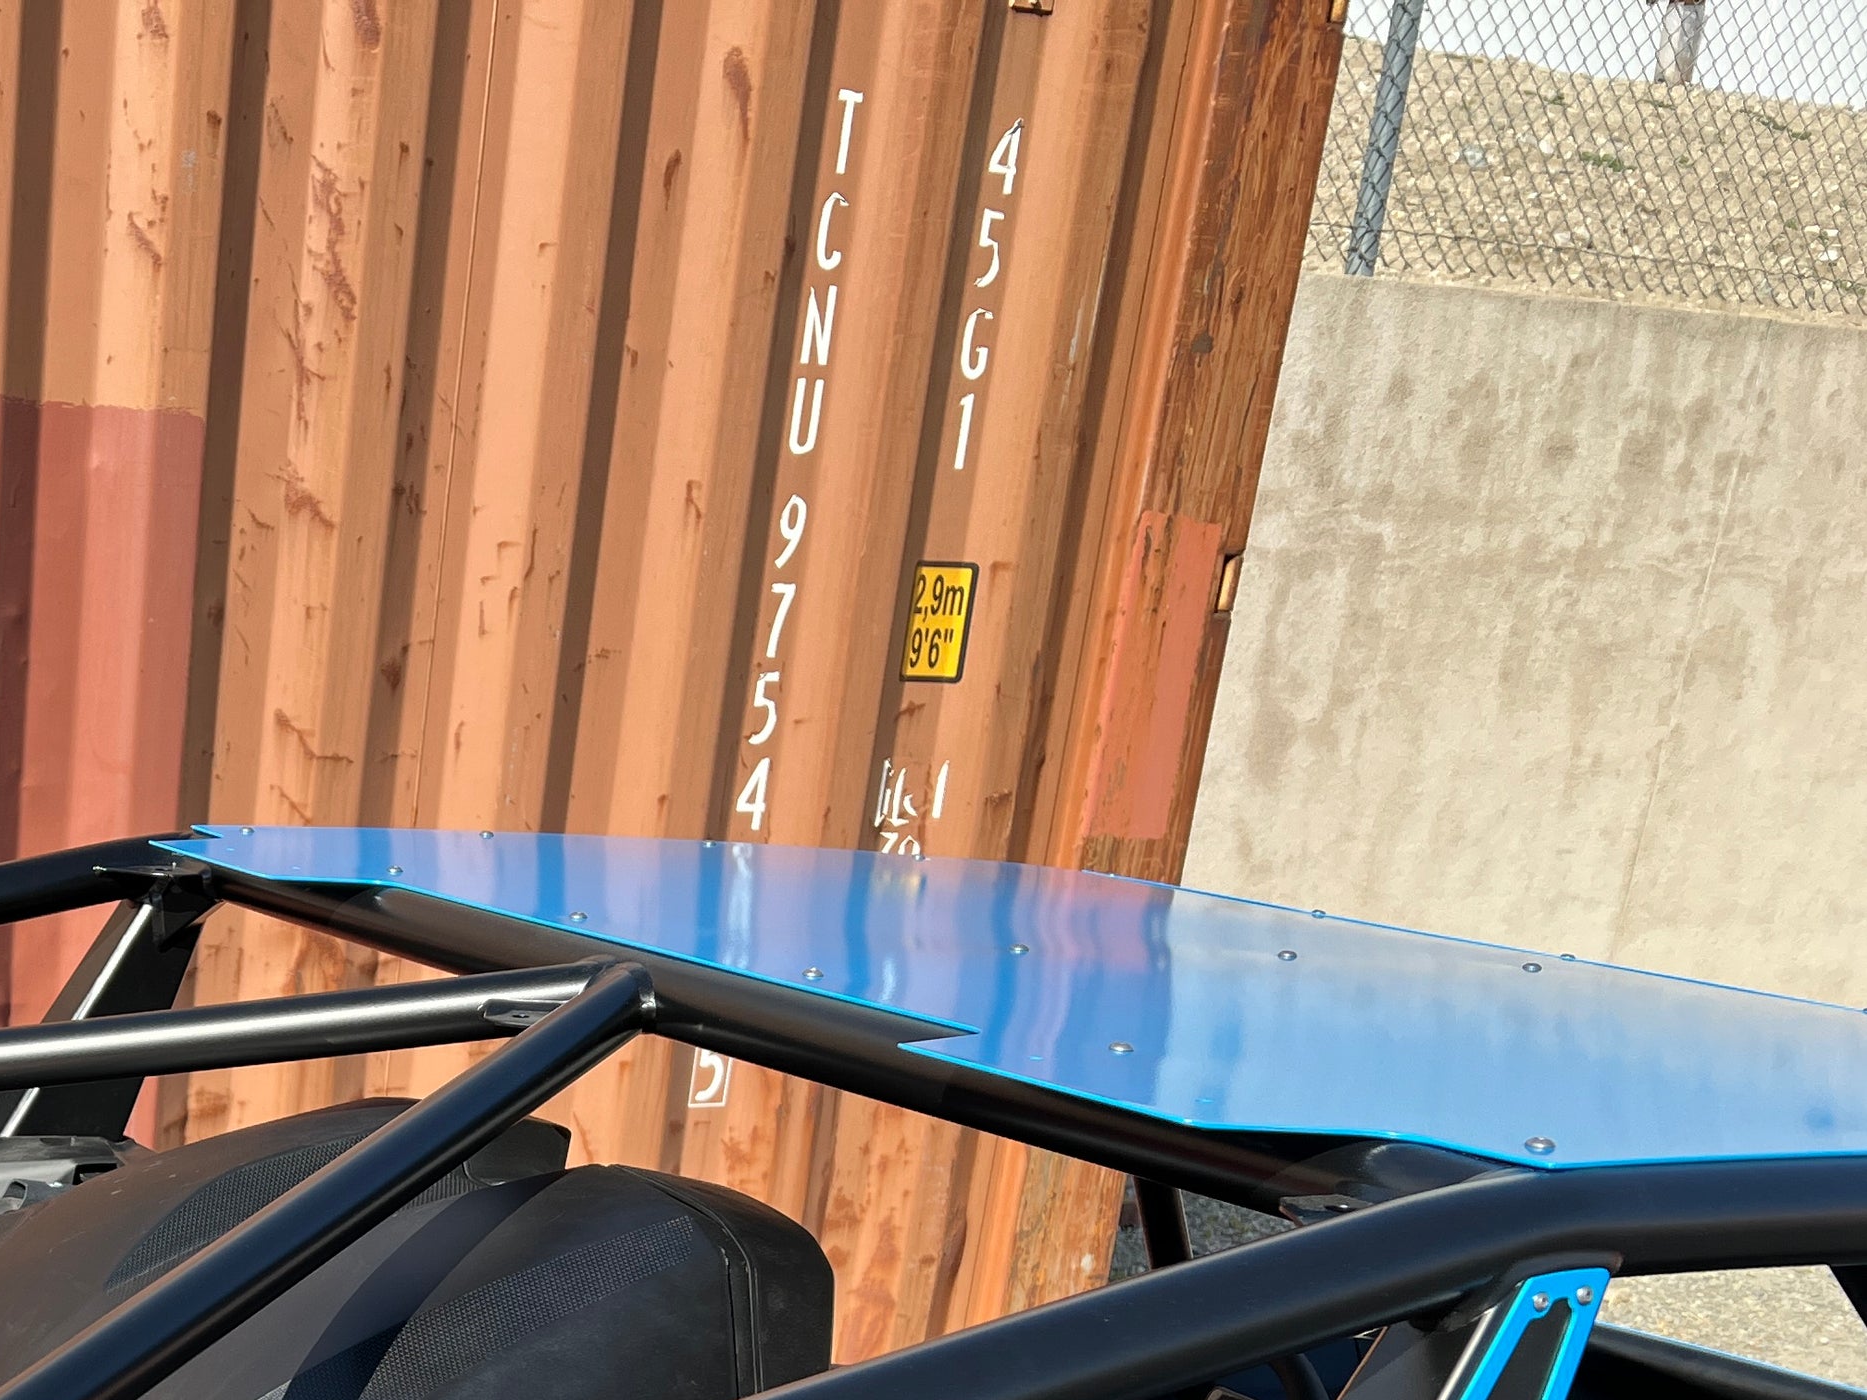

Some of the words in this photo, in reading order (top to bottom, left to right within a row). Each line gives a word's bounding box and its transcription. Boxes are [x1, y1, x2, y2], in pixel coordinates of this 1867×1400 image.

[788, 88, 864, 455] TCNU
[953, 117, 1024, 470] 45G1
[914, 574, 965, 622] 2,9m
[909, 627, 954, 669] 9'6"
[694, 1047, 725, 1102] 5
